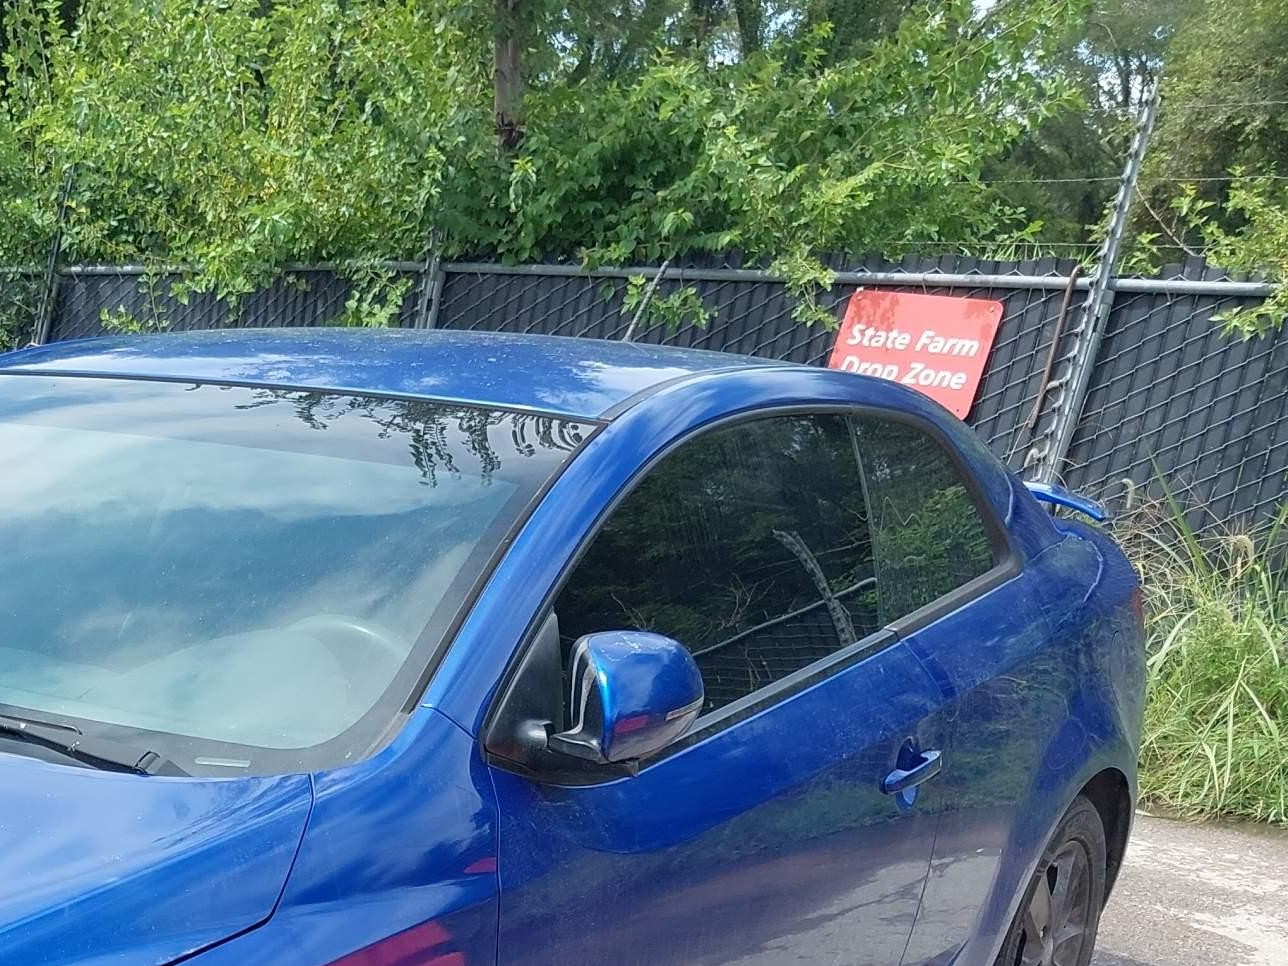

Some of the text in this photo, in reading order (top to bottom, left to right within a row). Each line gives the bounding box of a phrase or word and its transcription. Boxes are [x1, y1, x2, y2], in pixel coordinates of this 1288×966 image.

[847, 323, 980, 357] State Farm
[901, 362, 967, 390] Zone
